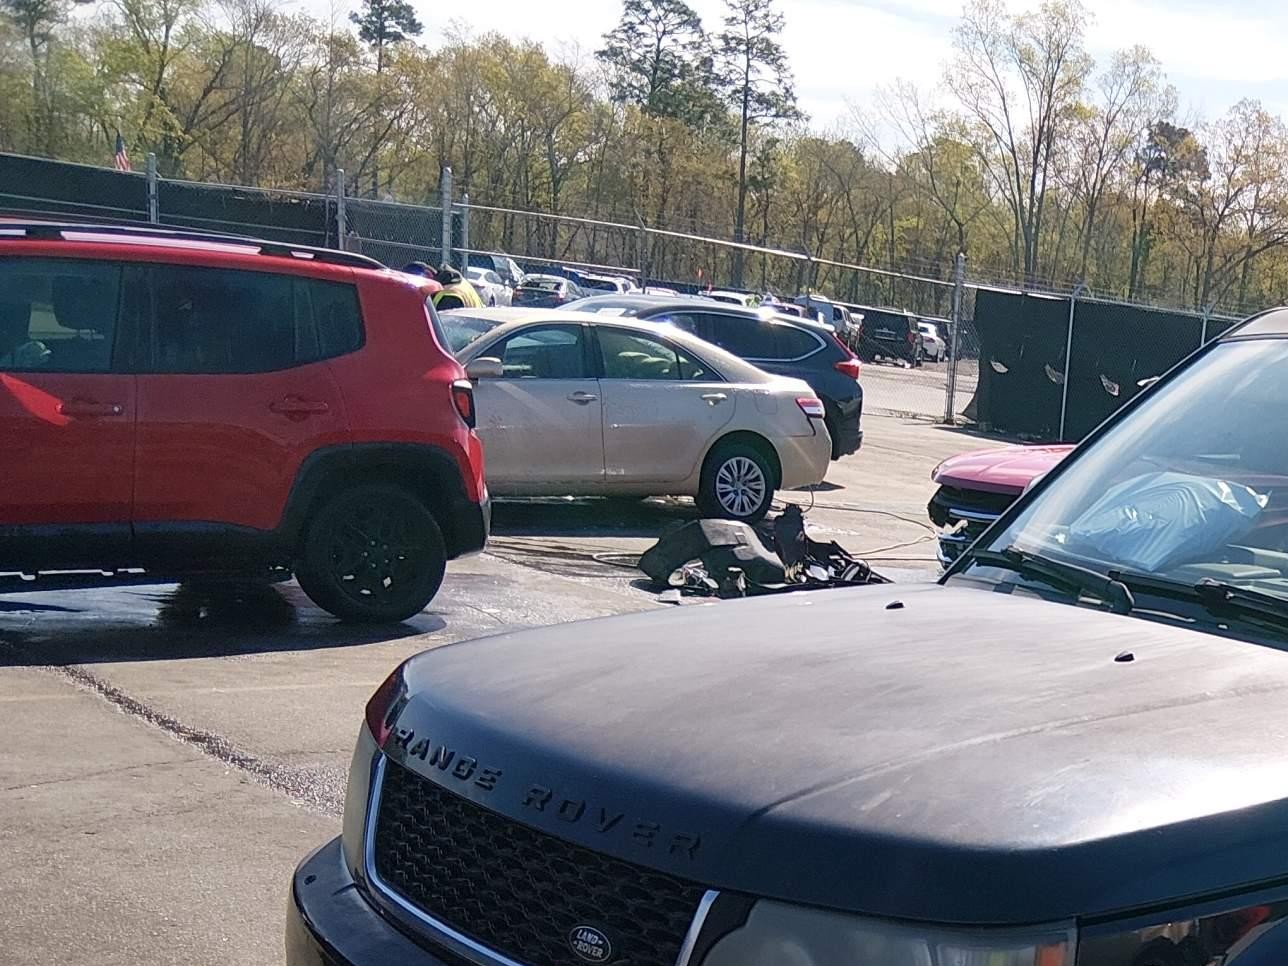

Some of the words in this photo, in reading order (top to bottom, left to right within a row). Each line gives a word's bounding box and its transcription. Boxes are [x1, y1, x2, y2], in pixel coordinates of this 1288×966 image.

[393, 728, 502, 792] RANGE
[521, 784, 702, 860] ROVER
[576, 929, 599, 945] LAND
[576, 941, 603, 958] ROVER
